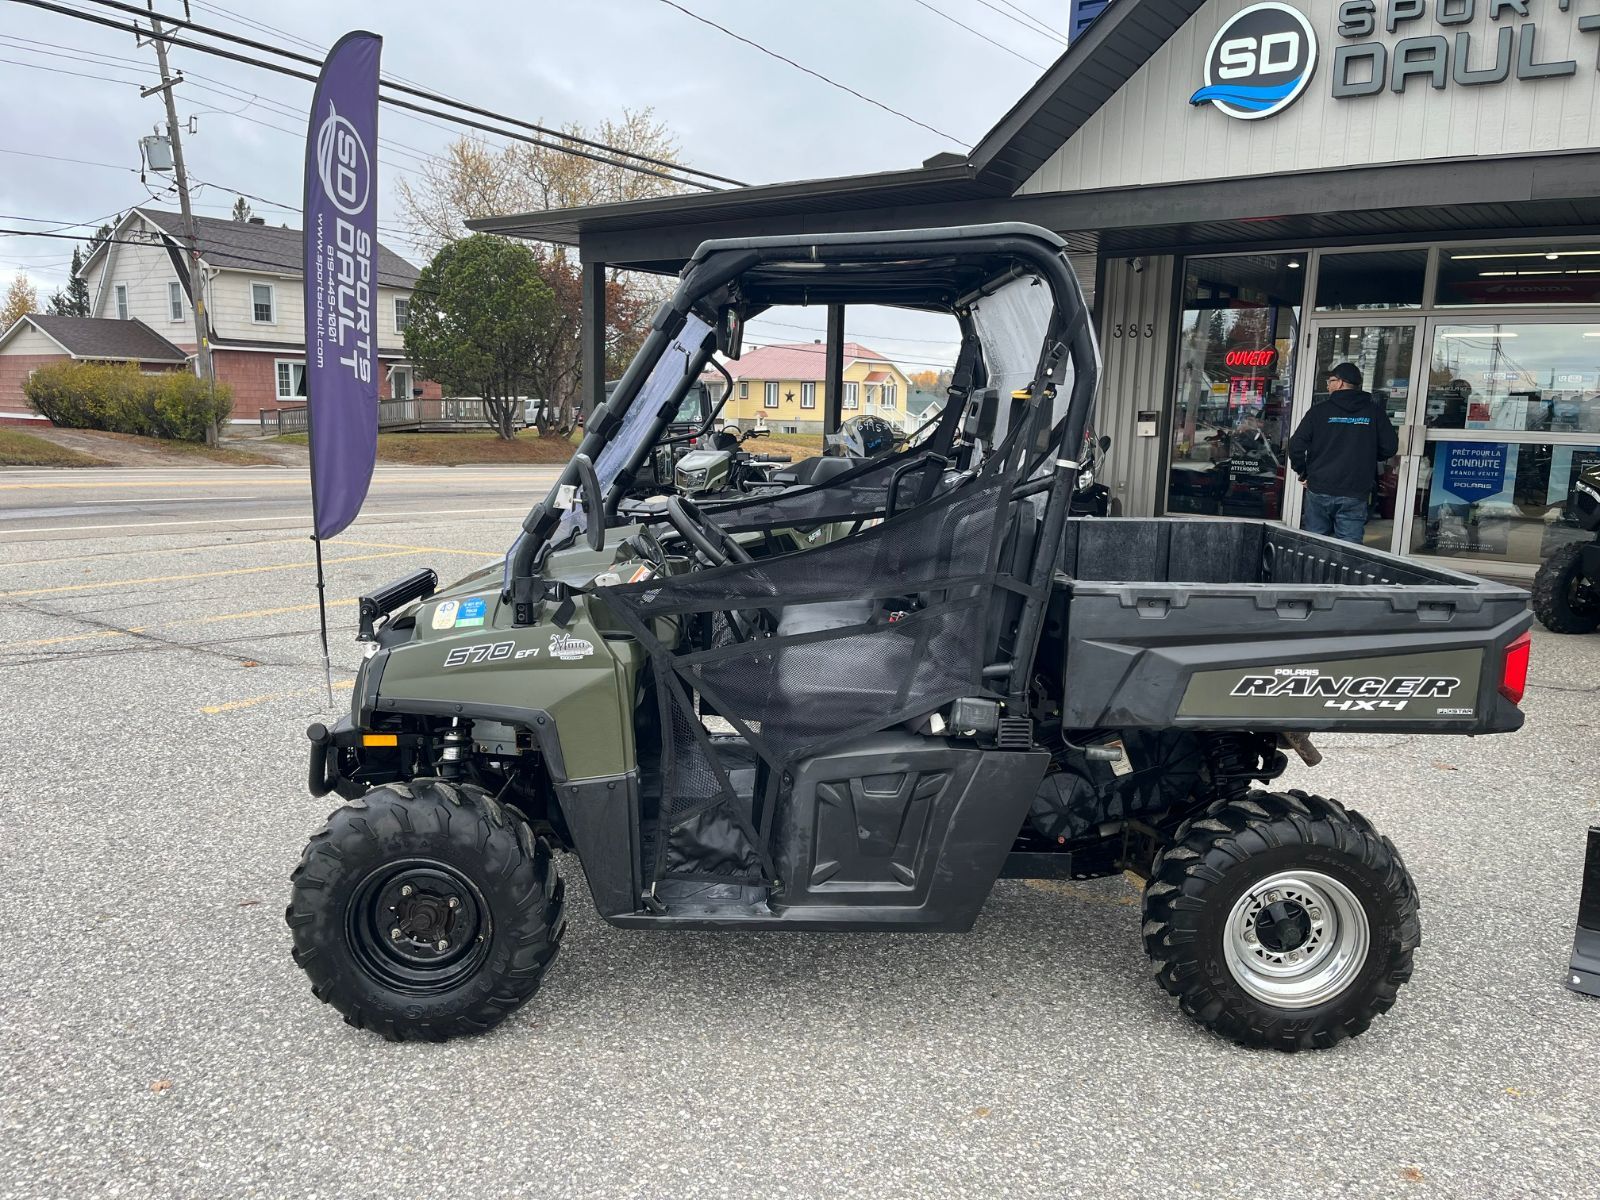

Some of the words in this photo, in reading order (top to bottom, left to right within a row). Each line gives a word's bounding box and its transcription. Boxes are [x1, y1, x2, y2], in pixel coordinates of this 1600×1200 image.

[1338, 0, 1569, 38] SPOR
[1218, 31, 1300, 80] SD
[337, 129, 357, 204] SD
[316, 212, 325, 369] www.sportsdault.com
[327, 245, 338, 343] 819-449-1001
[336, 217, 359, 379] DAULT
[356, 229, 371, 384] SPORTS
[1113, 323, 1154, 339] 383
[1225, 350, 1275, 366] OUVERT
[1451, 458, 1501, 469] CONDUITE
[1452, 448, 1471, 456] PRÊT
[1471, 449, 1490, 457] POUR
[444, 641, 515, 667] 570
[514, 648, 540, 659] EFI
[1230, 675, 1461, 698] RANGER
[1274, 668, 1319, 676] POLARIS
